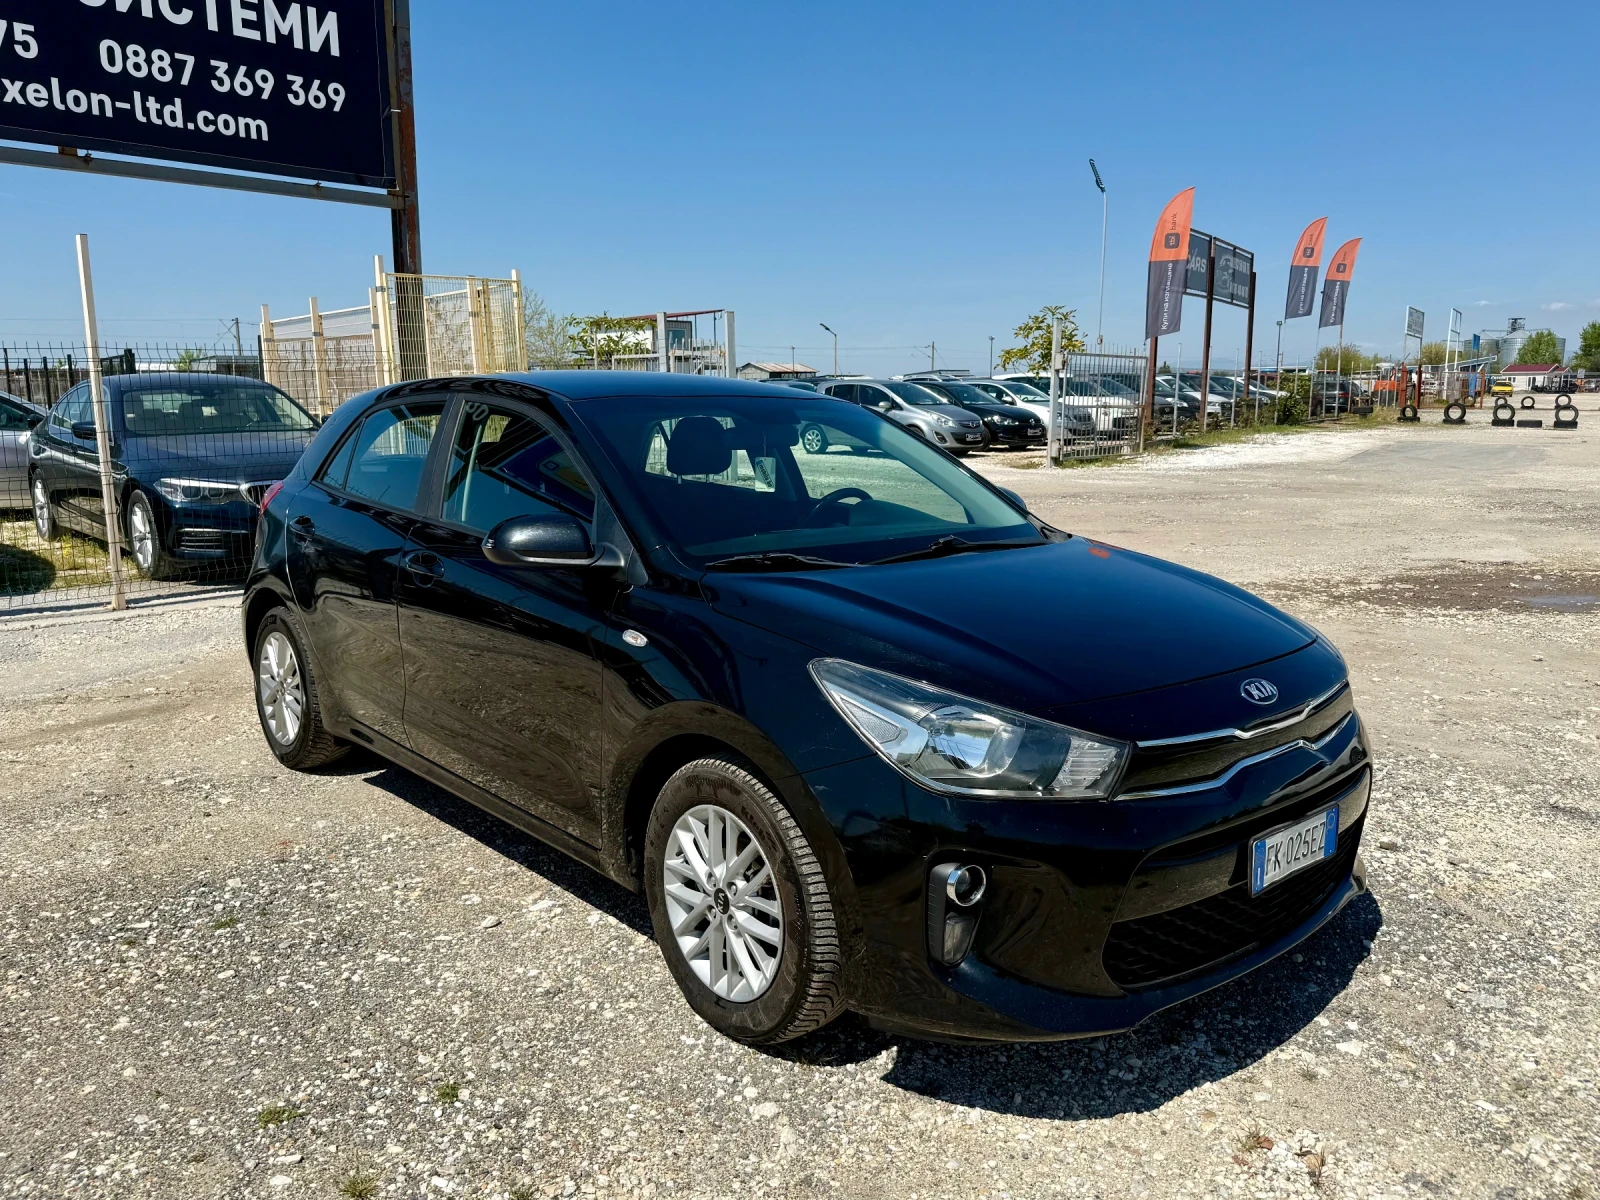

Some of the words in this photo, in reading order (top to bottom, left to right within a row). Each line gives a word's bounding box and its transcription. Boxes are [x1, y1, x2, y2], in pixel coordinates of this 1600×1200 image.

[78, 0, 340, 57] СТЕМИ
[100, 39, 195, 86] 0887
[210, 60, 274, 100] 369
[286, 74, 346, 112] 369
[0, 77, 269, 141] xelon-ltd.com
[1163, 303, 1169, 312] на
[1161, 313, 1169, 330] Купи
[1244, 680, 1276, 700] KIA
[717, 892, 725, 913] KIA
